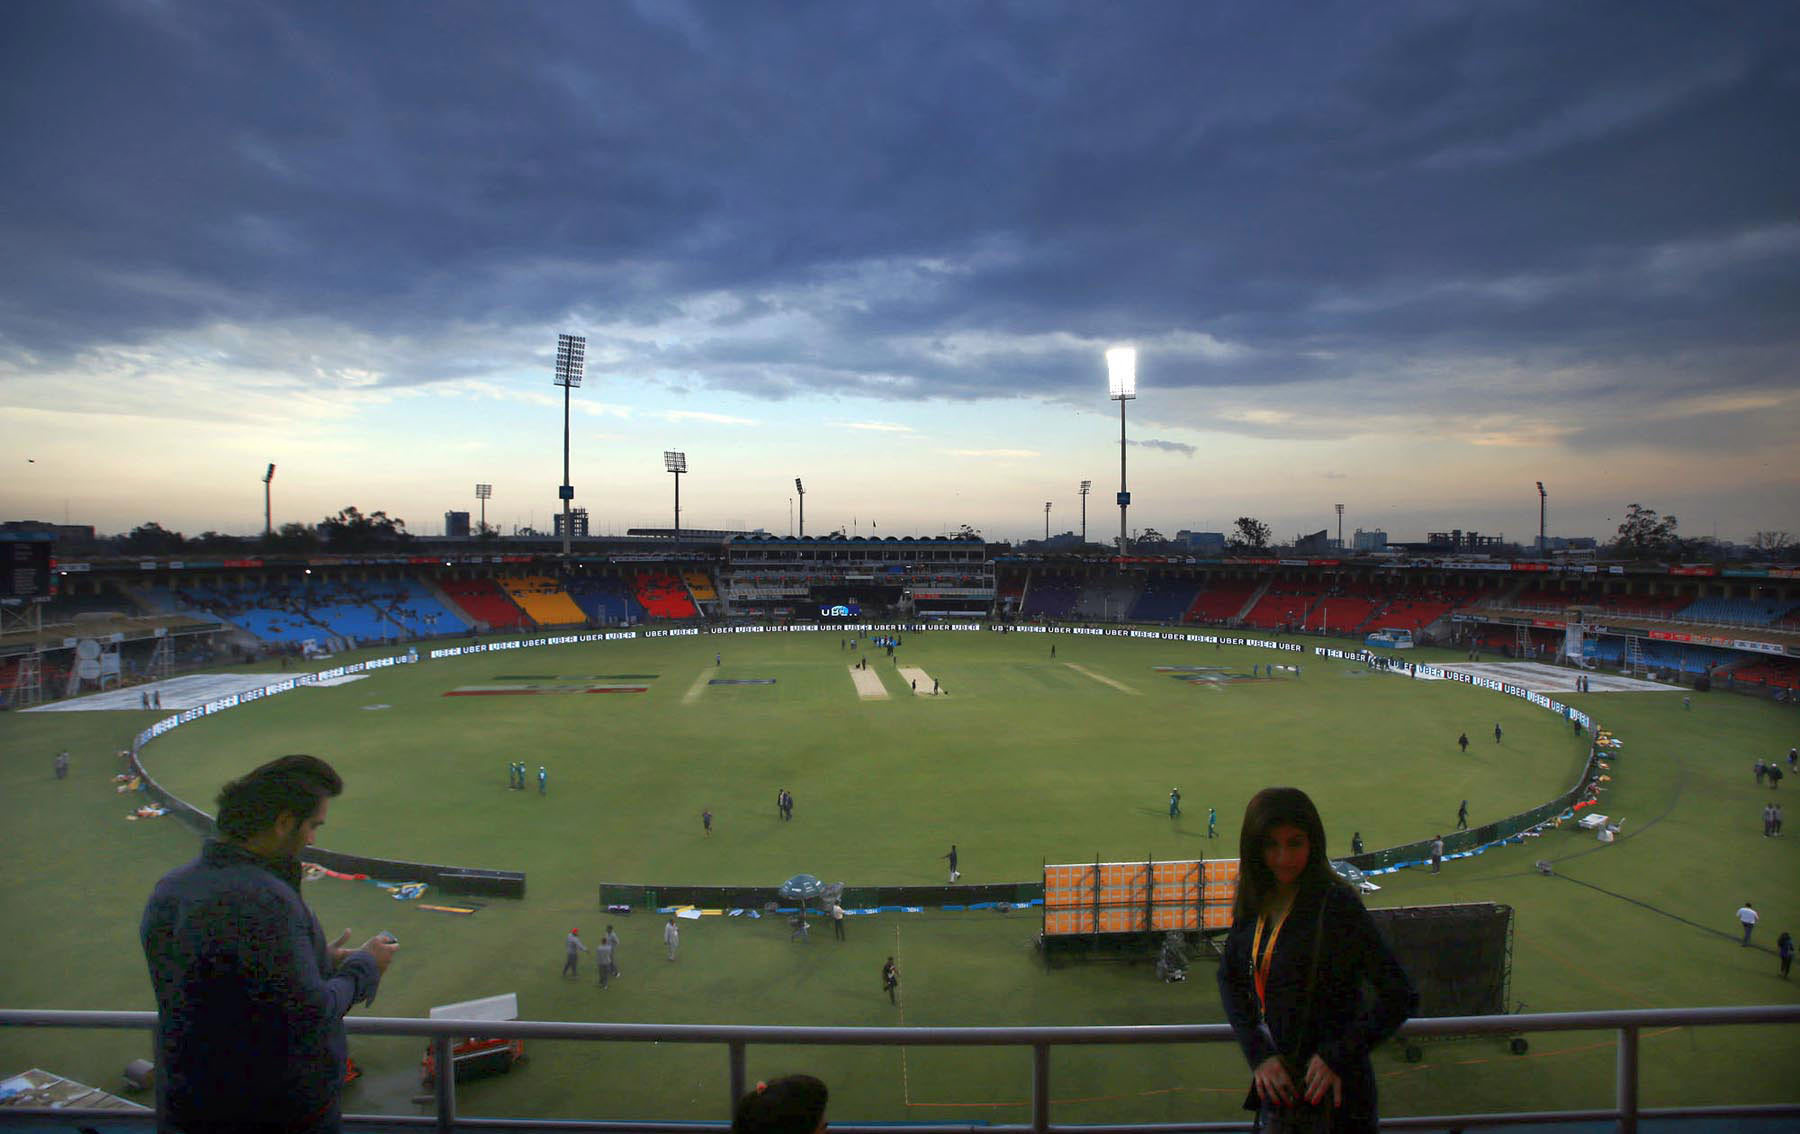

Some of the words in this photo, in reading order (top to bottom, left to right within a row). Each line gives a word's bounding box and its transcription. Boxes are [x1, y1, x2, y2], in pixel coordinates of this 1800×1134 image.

[672, 628, 698, 636] UBER
[1075, 627, 1101, 635] UBER
[1189, 635, 1216, 643] UBER
[1248, 640, 1275, 648] UBER
[1279, 643, 1302, 652] UBER
[434, 648, 460, 658] UBER
[463, 645, 488, 654] UBER
[491, 641, 519, 650] UBER
[522, 639, 547, 647] UBER
[550, 636, 576, 644] UBER
[179, 706, 205, 723] UBER
[240, 688, 265, 703] UBER
[296, 674, 317, 687] UBER
[345, 663, 364, 674] UBER
[1344, 651, 1367, 661] UBER
[1418, 664, 1443, 677] UBER
[1446, 670, 1471, 683] UBER
[1474, 675, 1501, 690] UBER
[1504, 684, 1526, 698] UBER
[1529, 691, 1549, 707] UBER
[1551, 700, 1566, 714] UBE
